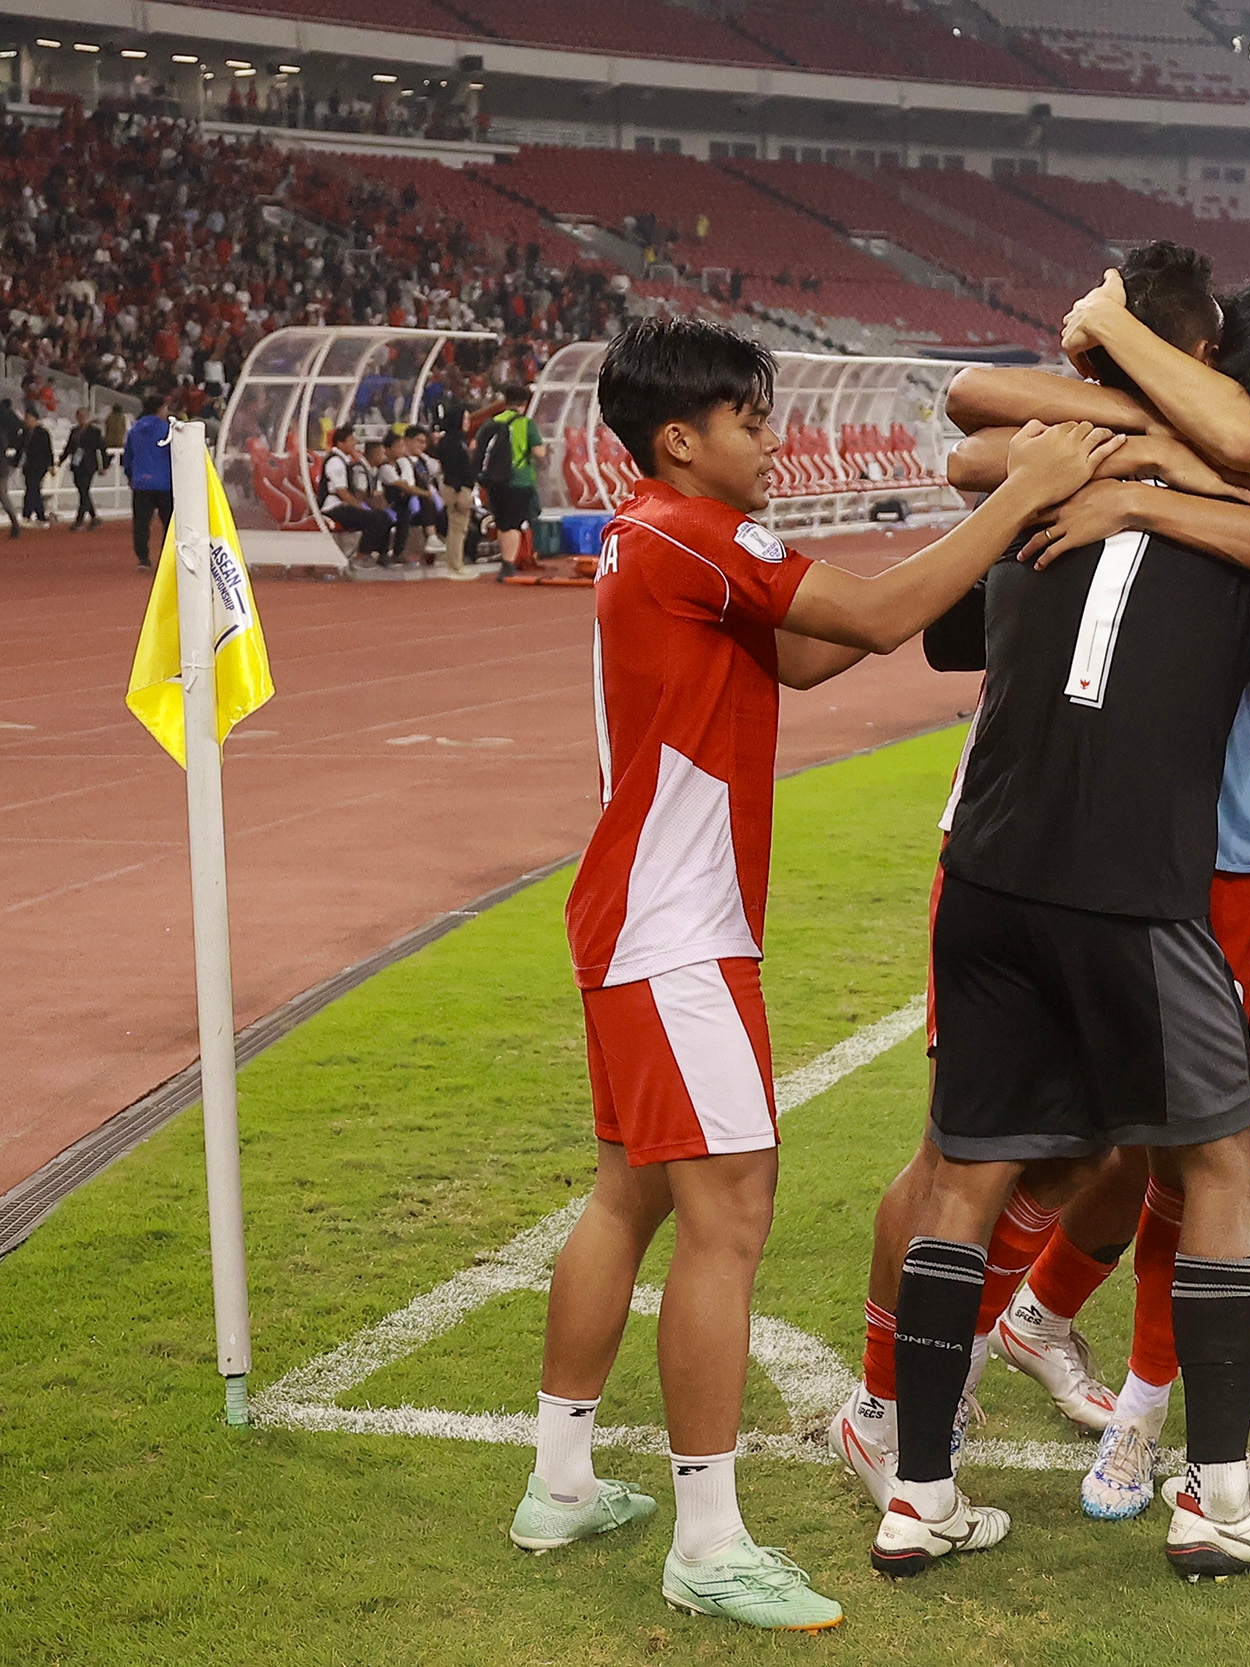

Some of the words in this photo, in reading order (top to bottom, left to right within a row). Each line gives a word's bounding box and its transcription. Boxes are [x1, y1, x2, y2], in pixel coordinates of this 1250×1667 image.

[211, 545, 242, 588] ASEAN
[1064, 526, 1150, 709] 1
[1015, 1309, 1042, 1325] SPECS
